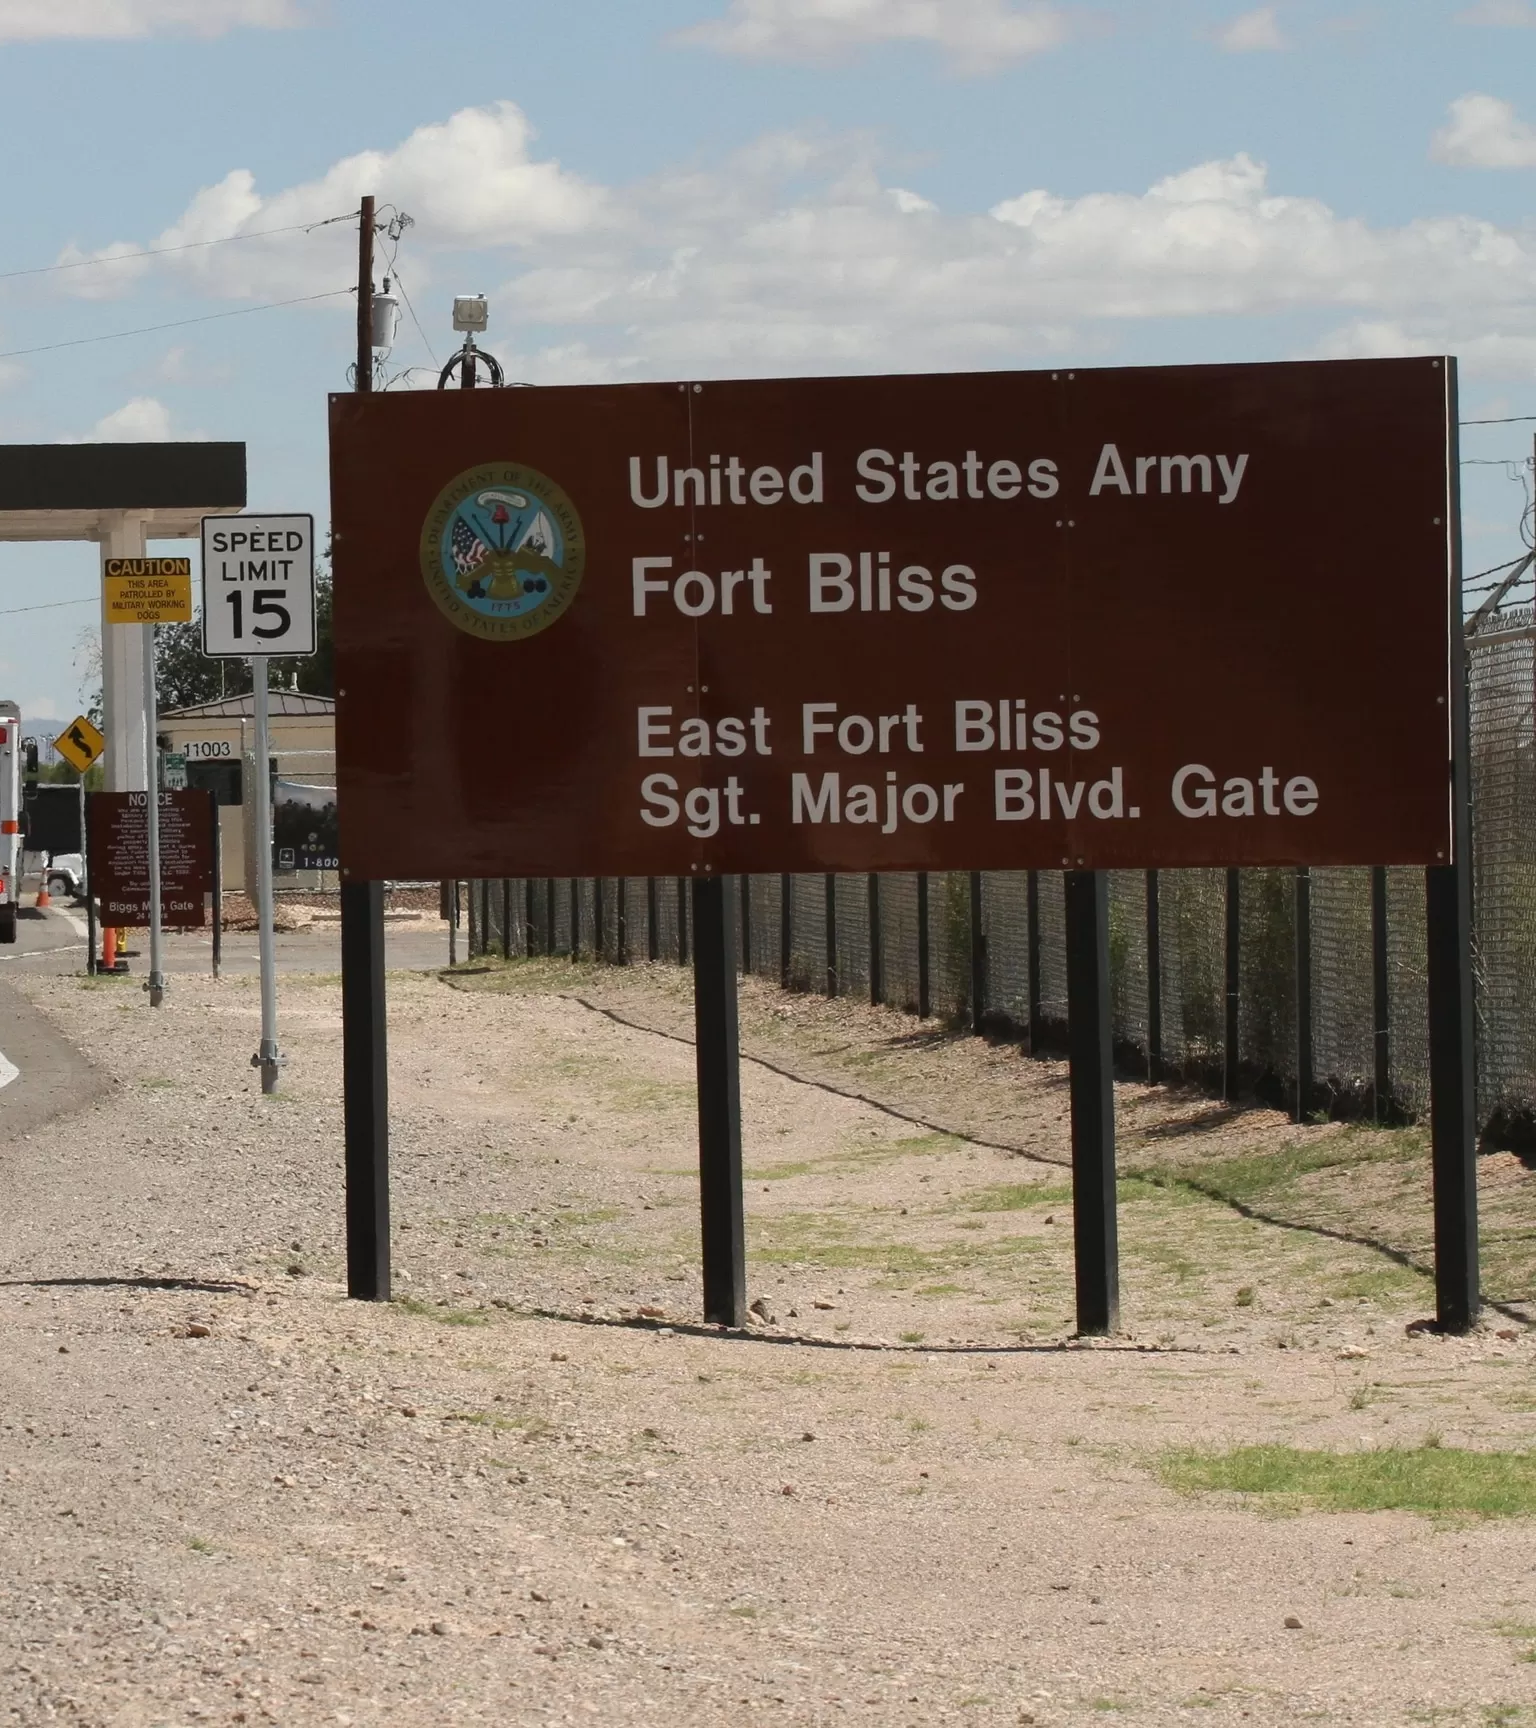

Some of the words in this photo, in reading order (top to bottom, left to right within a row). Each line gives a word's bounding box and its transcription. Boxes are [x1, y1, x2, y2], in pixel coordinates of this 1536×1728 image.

[629, 451, 824, 509] United
[855, 448, 1060, 504] States
[1088, 443, 1250, 504] Army
[427, 471, 496, 545] DEPARTMENT
[503, 470, 521, 482] OF
[553, 503, 579, 542] ARMY
[212, 531, 303, 553] SPEED
[108, 559, 188, 576] CAUTION
[222, 560, 293, 581] LIMIT
[128, 580, 145, 588] THIS
[147, 579, 169, 588] AREA
[632, 556, 773, 617] Fort
[808, 551, 978, 613] Bliss
[120, 590, 163, 599] PATROLLED
[166, 589, 176, 598] BY
[428, 558, 460, 613] UNITED
[463, 612, 517, 634] STATES
[523, 616, 540, 631] OF
[112, 601, 145, 610] MILITARY
[147, 600, 185, 609] WORKING
[226, 589, 291, 639] 15
[491, 601, 521, 613] 1775
[137, 611, 160, 620] DOGS
[637, 705, 773, 758] East
[802, 702, 924, 755] Fort
[955, 699, 1101, 752] Bliss
[183, 741, 231, 757] 11003
[128, 792, 173, 807] NOCE
[639, 772, 761, 838] Sgt.
[791, 771, 965, 834] Major
[994, 766, 1141, 821] Blvd.
[1171, 763, 1319, 819] Gate
[109, 901, 138, 913] Biggs
[142, 901, 166, 911] Mn
[169, 900, 194, 911] Gate
